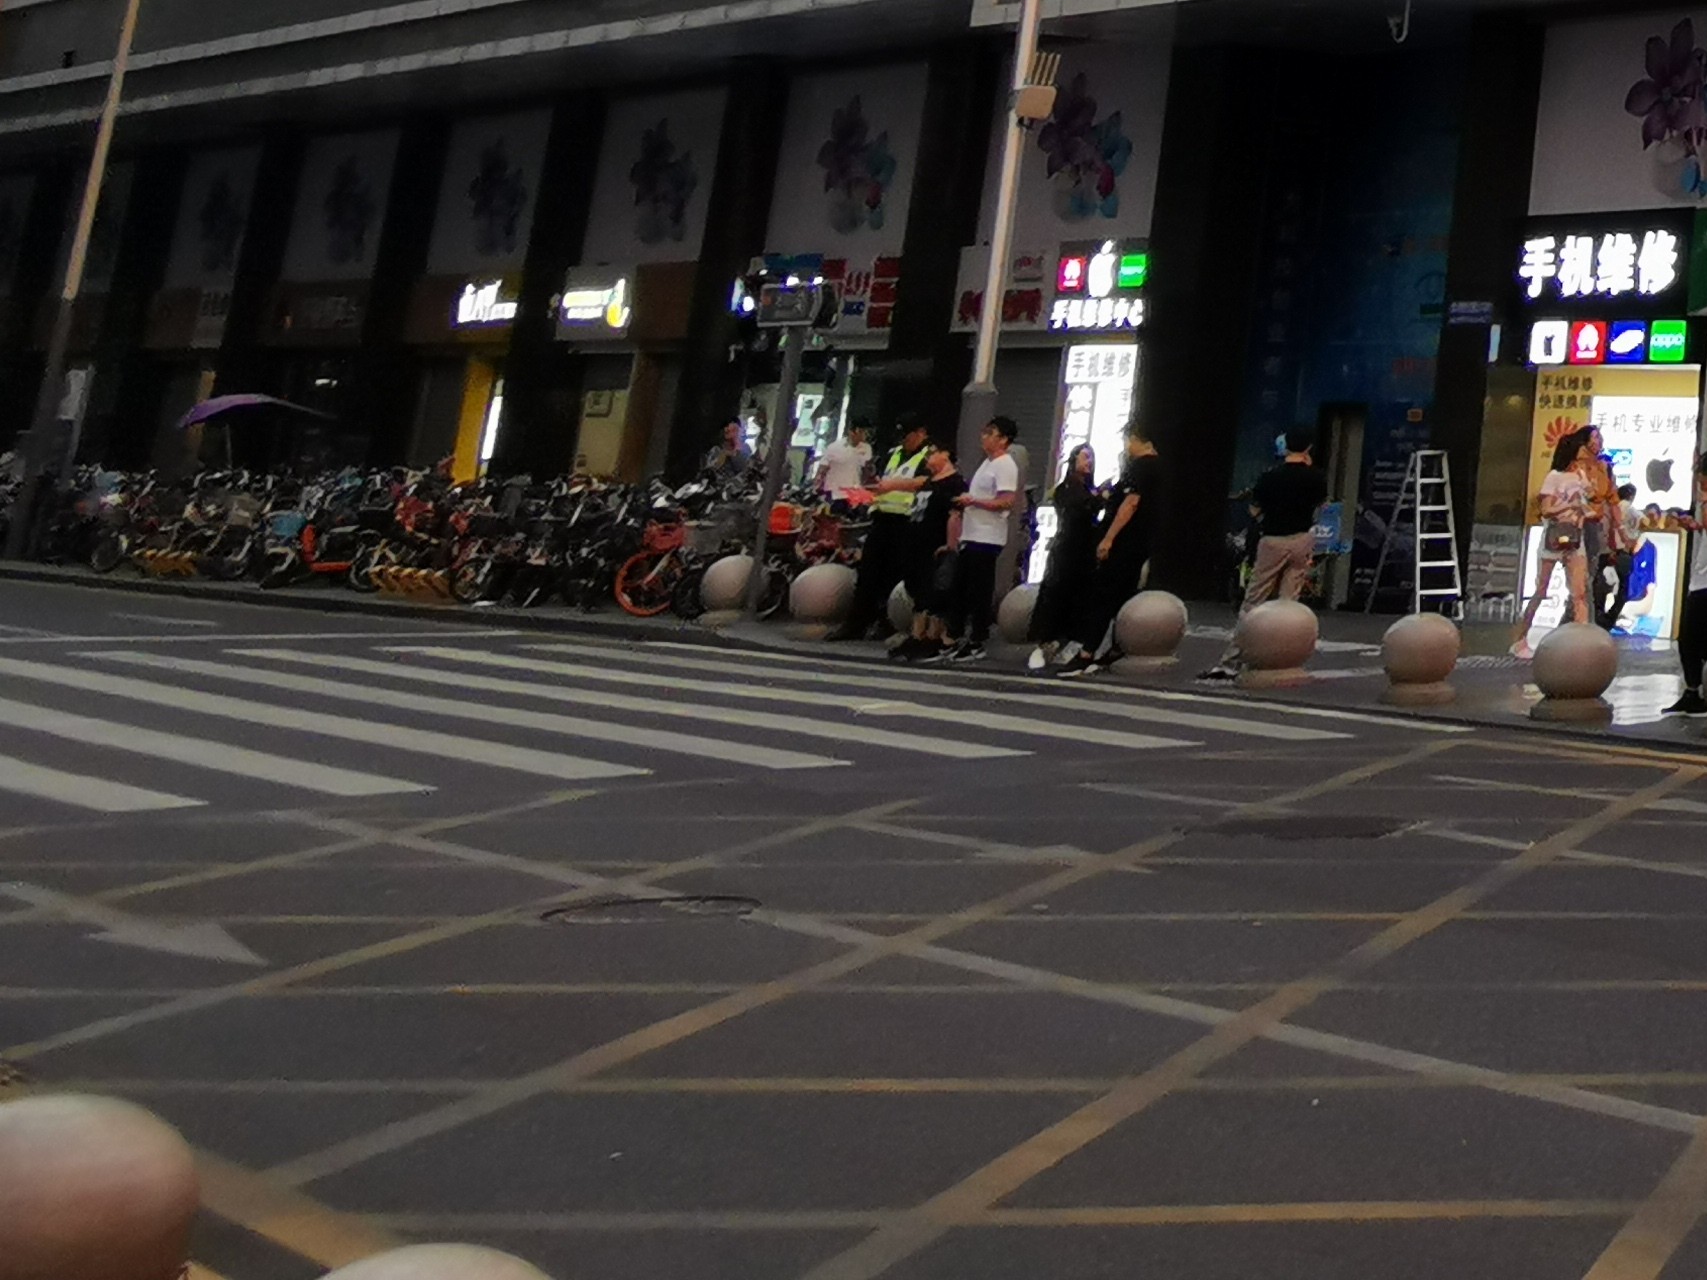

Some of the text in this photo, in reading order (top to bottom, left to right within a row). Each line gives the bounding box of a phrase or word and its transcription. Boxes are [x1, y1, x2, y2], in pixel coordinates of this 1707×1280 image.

[1519, 230, 1678, 298] 手机维修
[1597, 412, 1698, 434] 手机专业维修
